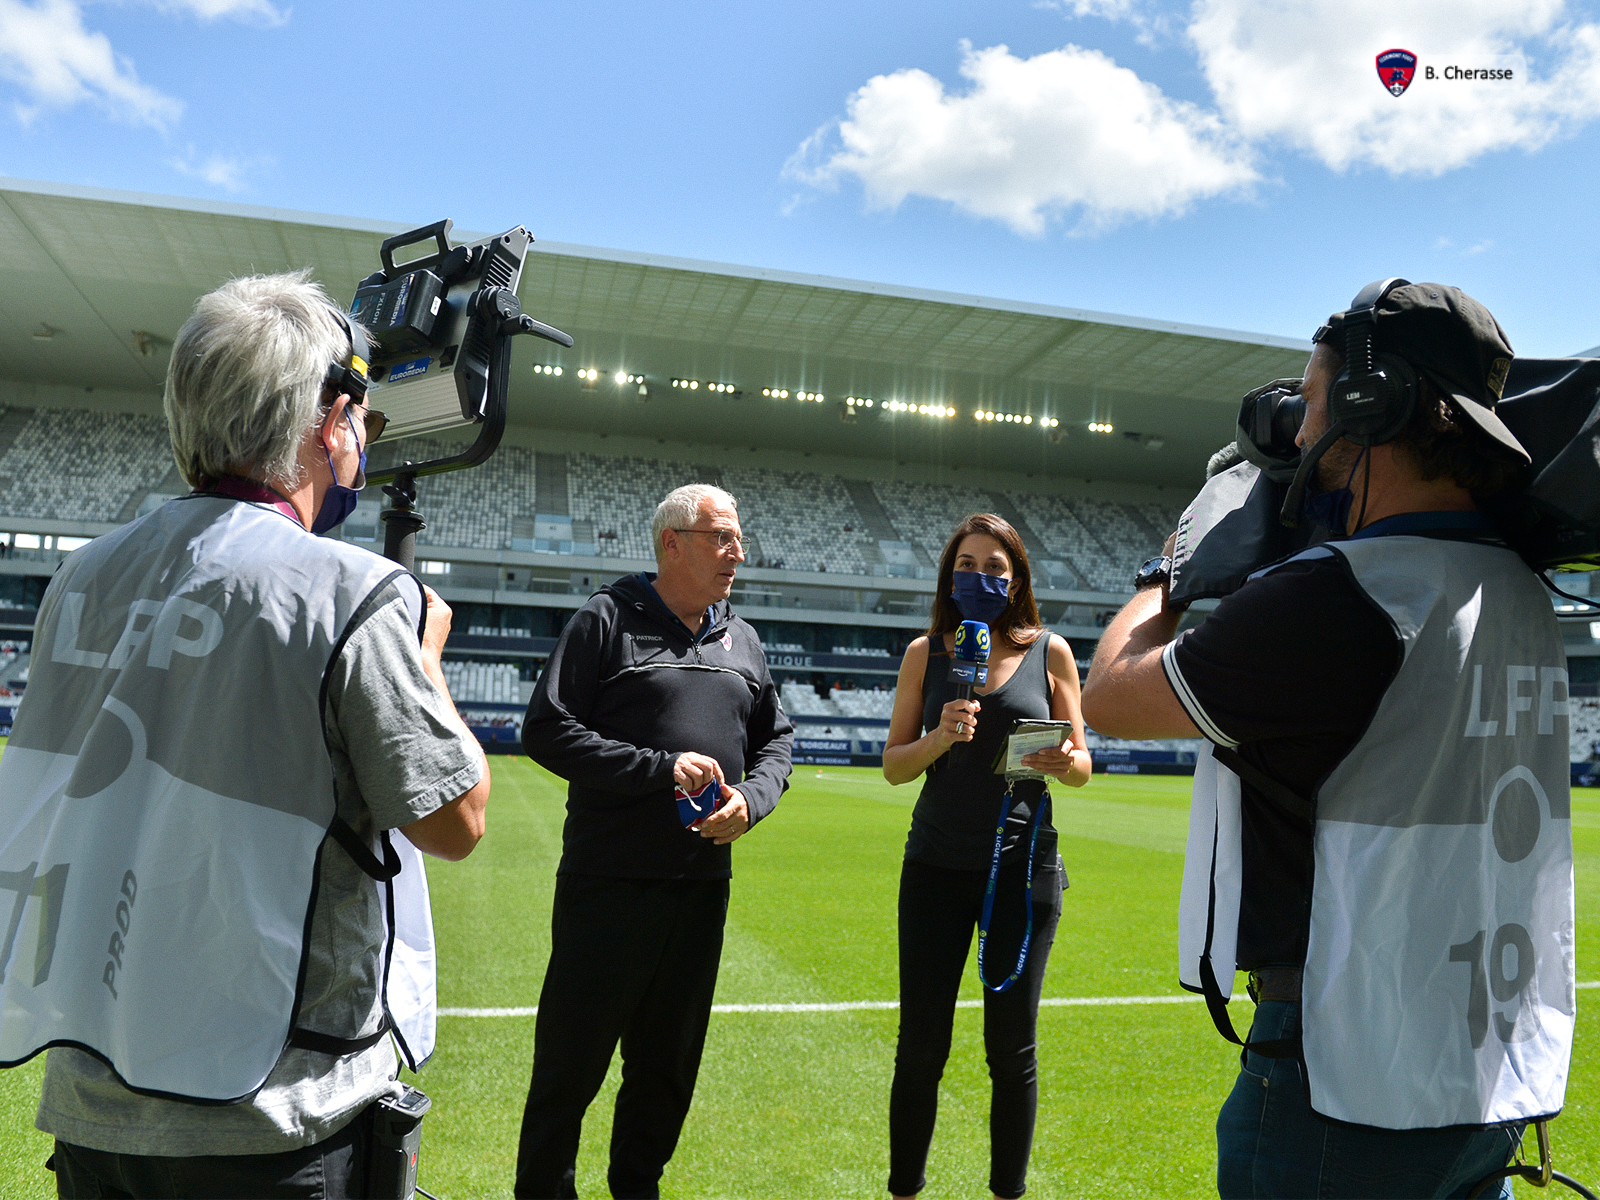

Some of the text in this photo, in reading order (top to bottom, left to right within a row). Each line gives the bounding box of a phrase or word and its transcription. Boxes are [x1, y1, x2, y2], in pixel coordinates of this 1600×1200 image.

[372, 292, 386, 324] FXLION
[389, 366, 427, 381] EUROMEDIA
[50, 591, 224, 670] LFP
[765, 655, 812, 667] TIQUE
[1464, 664, 1569, 737] LFP
[801, 741, 848, 750] BORDEAUX
[993, 835, 1001, 858] LIGUE
[102, 869, 138, 1001] PROD
[1449, 922, 1542, 1049] 19
